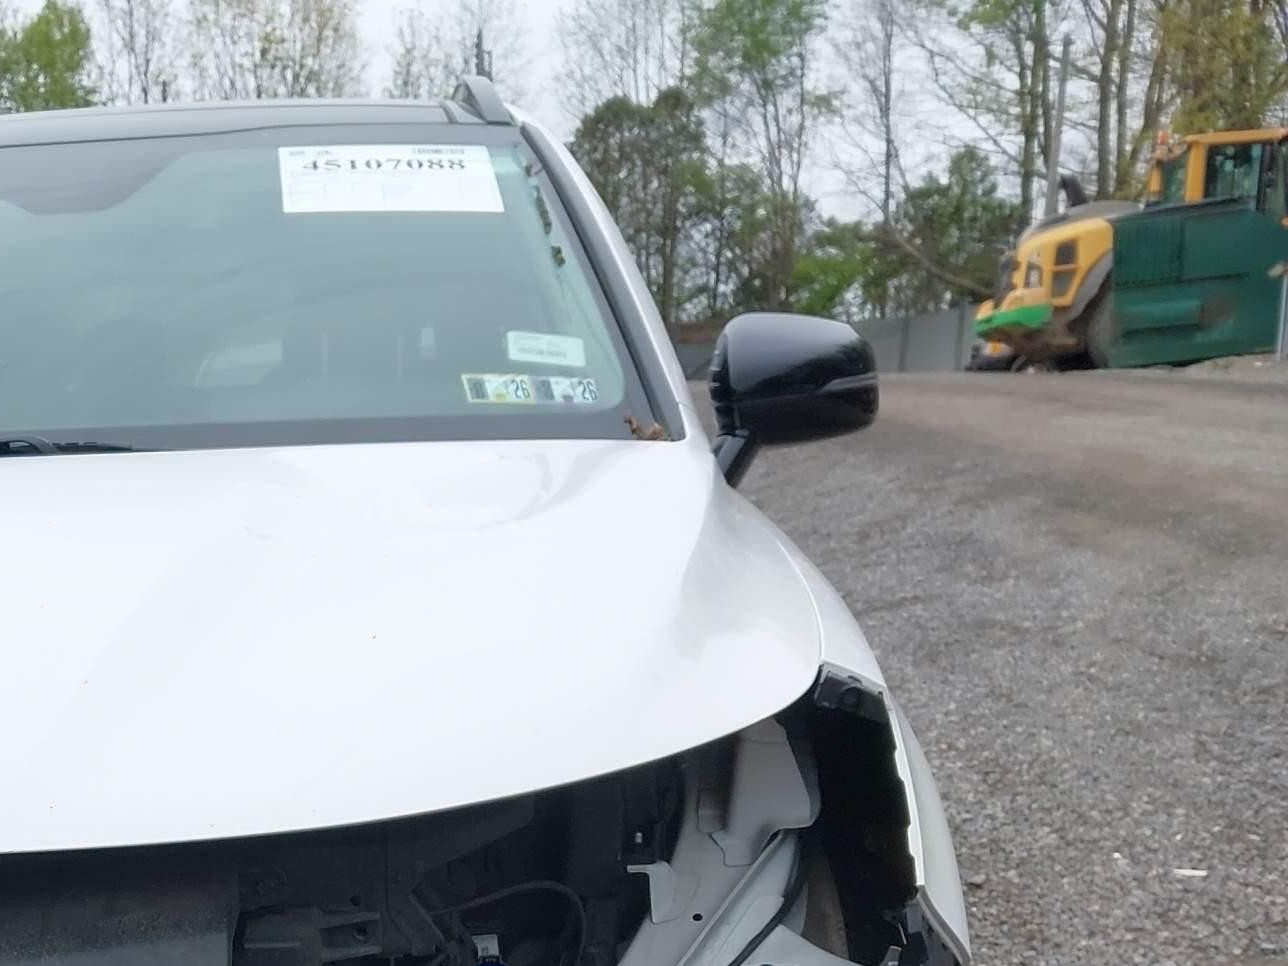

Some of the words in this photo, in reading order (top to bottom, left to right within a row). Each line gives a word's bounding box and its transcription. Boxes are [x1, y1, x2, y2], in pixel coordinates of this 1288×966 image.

[302, 158, 466, 171] 45107088
[511, 379, 531, 399] 26
[577, 380, 599, 401] 26
